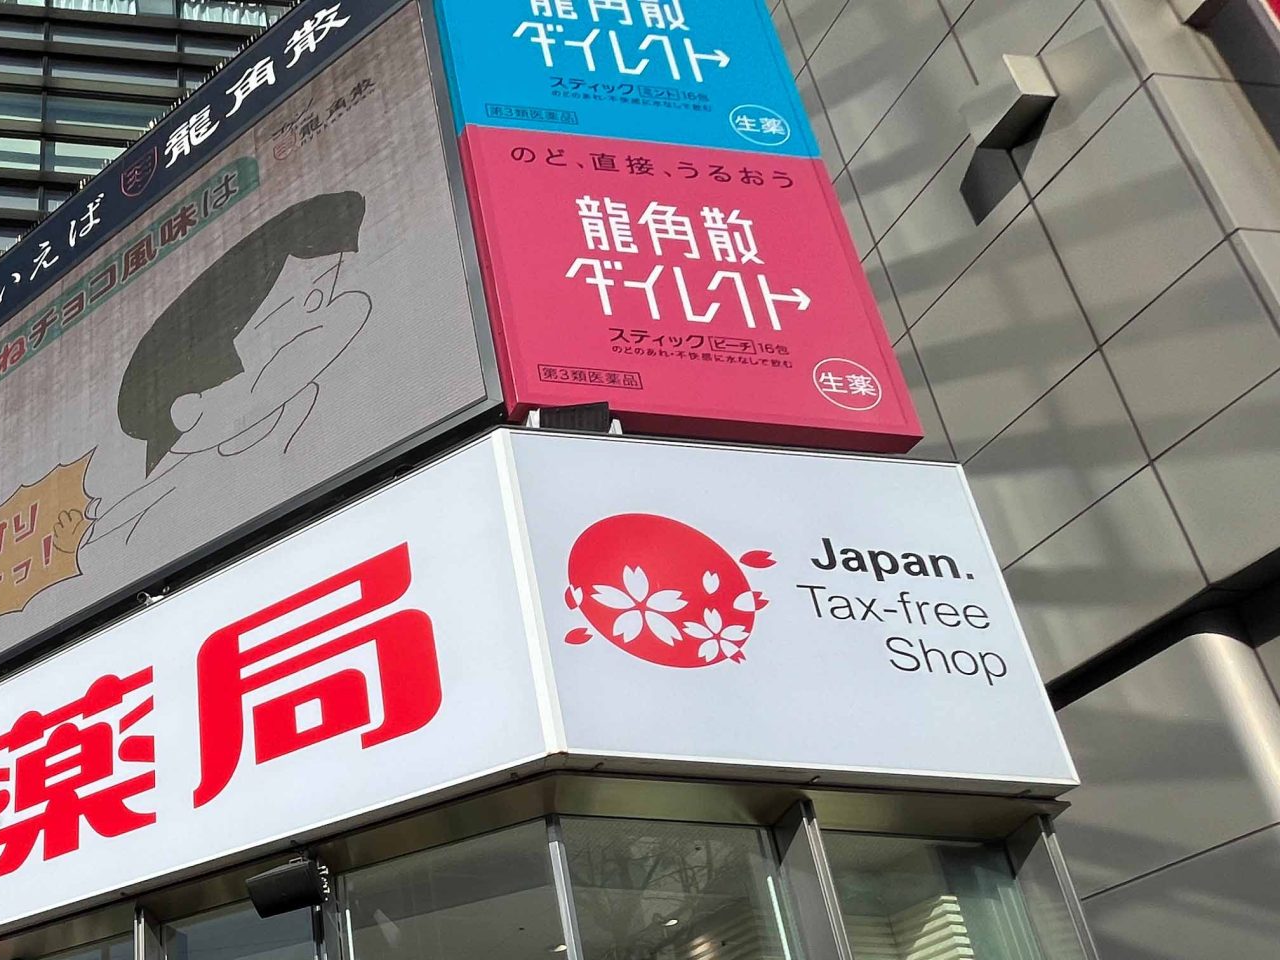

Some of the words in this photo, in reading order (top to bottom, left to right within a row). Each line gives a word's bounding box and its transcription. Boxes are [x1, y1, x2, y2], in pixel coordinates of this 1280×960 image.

[512, 21, 730, 83] ダイレクト
[164, 2, 351, 168] 龍角散
[549, 76, 633, 95] スティック
[735, 114, 786, 134] 生薬
[510, 143, 795, 189] のど、直接、うるおう
[576, 195, 765, 266] 龍角散
[565, 257, 811, 331] ダイレクト
[609, 328, 705, 349] スティック
[542, 367, 640, 387] 第3類医薬品
[819, 371, 877, 397] 生薬
[811, 537, 975, 581] Japan.
[796, 583, 991, 631] Tax-free
[885, 636, 1008, 686] Shop
